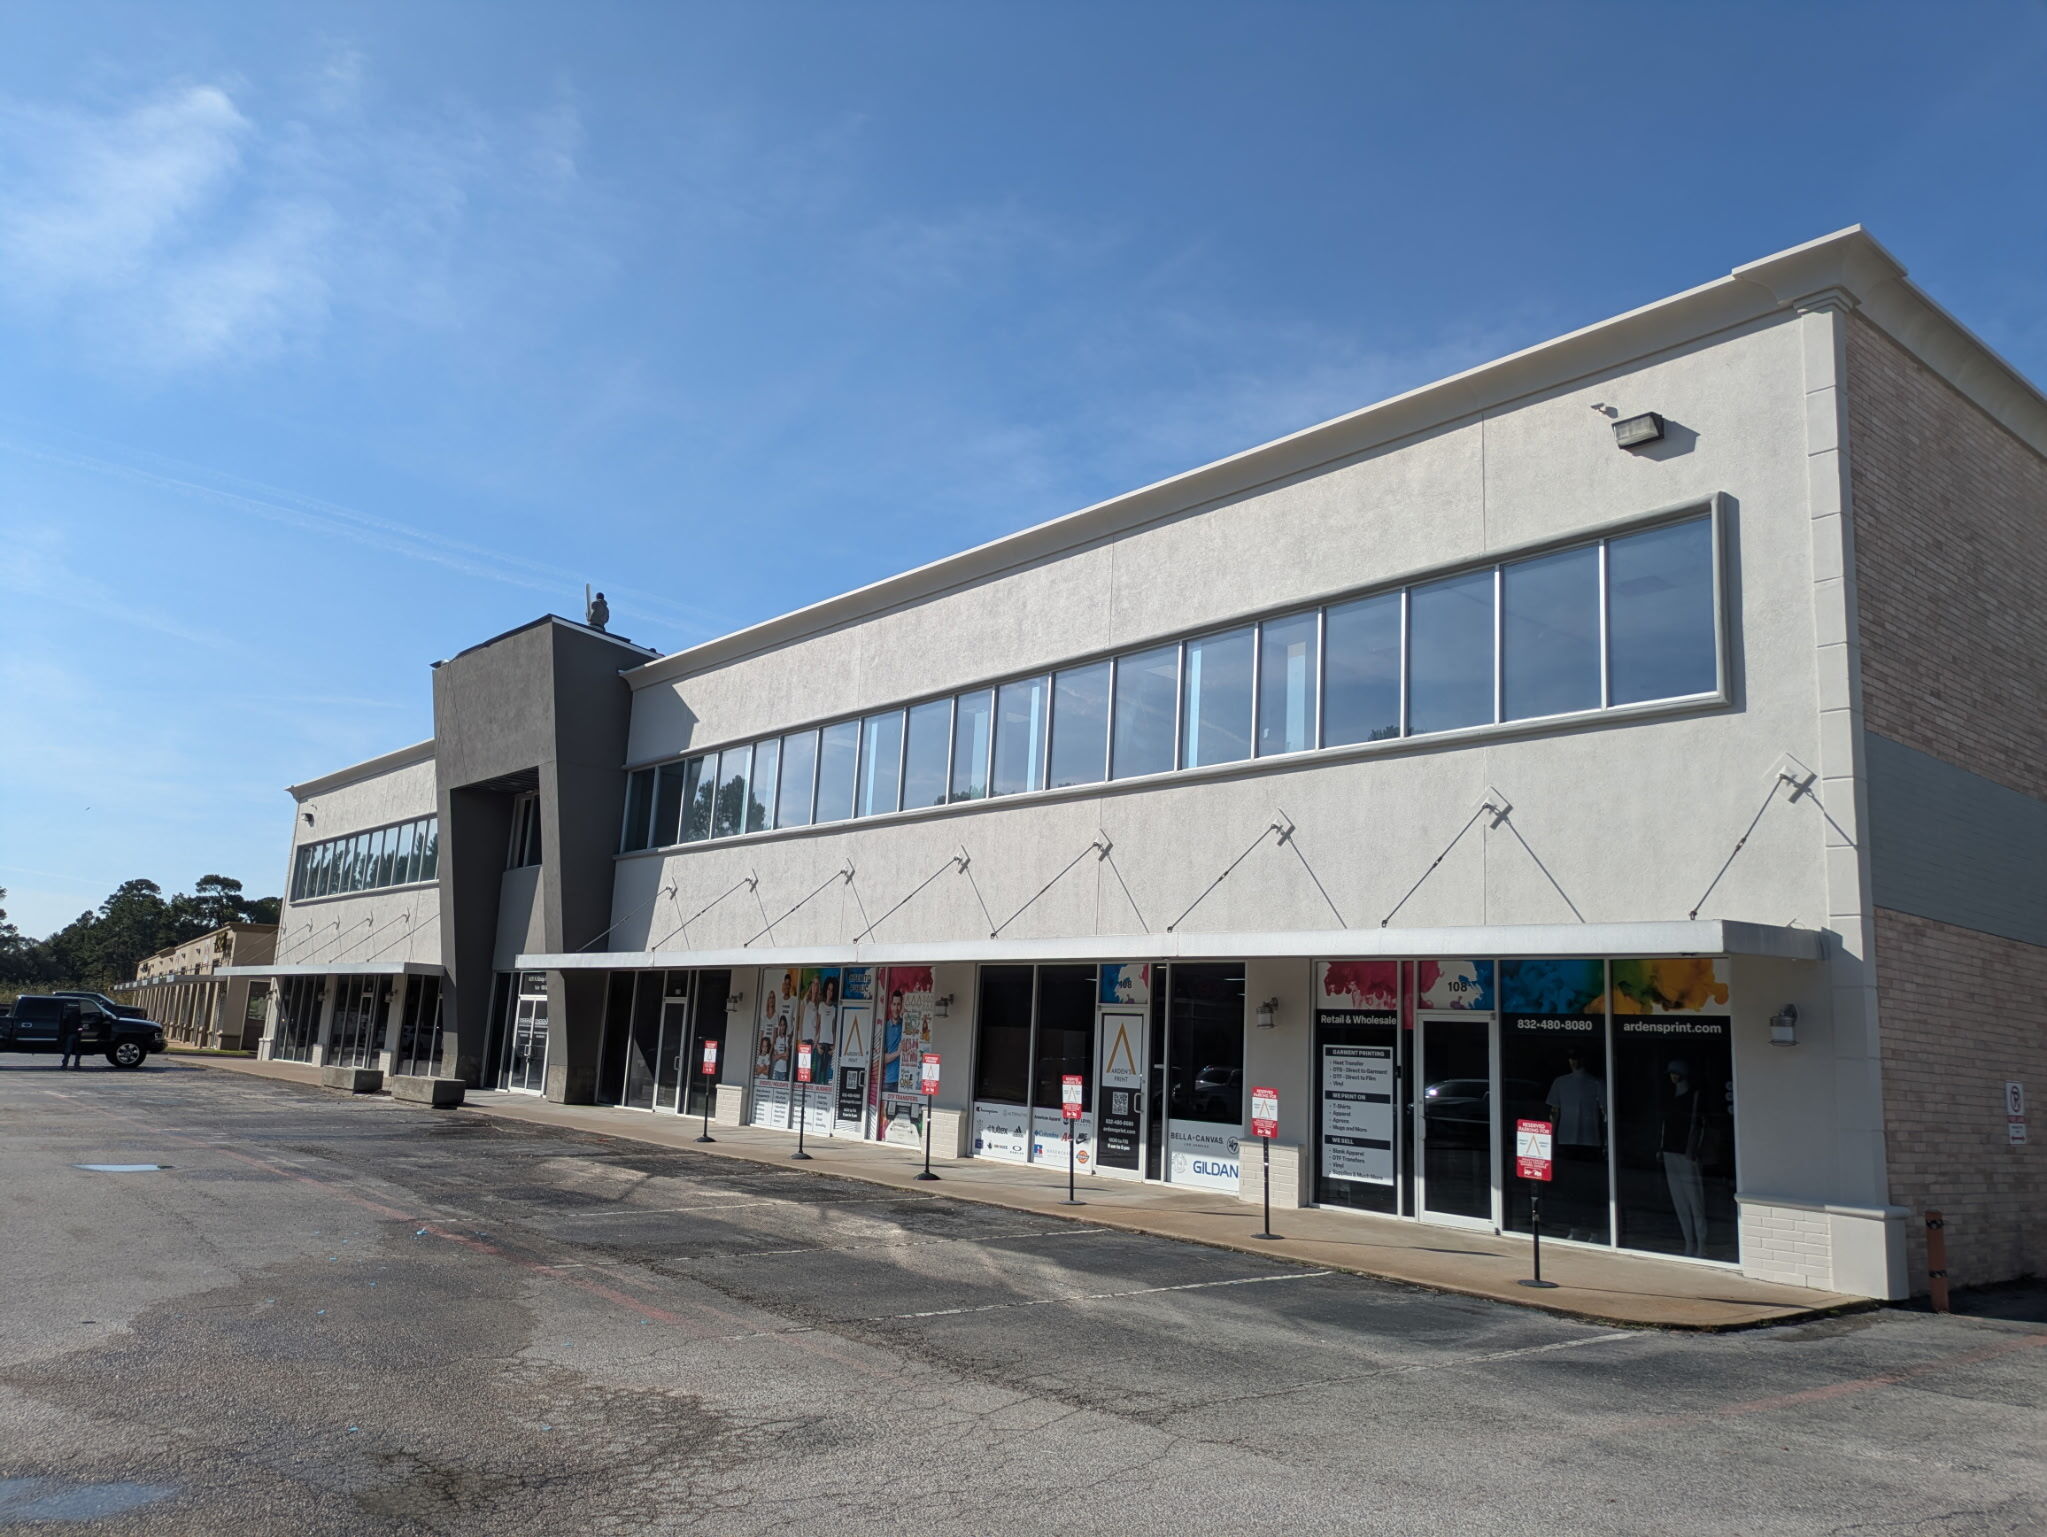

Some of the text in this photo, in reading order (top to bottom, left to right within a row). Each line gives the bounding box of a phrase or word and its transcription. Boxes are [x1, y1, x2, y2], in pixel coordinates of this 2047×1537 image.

[1447, 981, 1468, 992] 108
[1320, 1014, 1397, 1025] Retail & Wholesale
[1623, 1021, 1722, 1035] ardensprint.com
[1193, 1160, 1239, 1179] GILDAN
